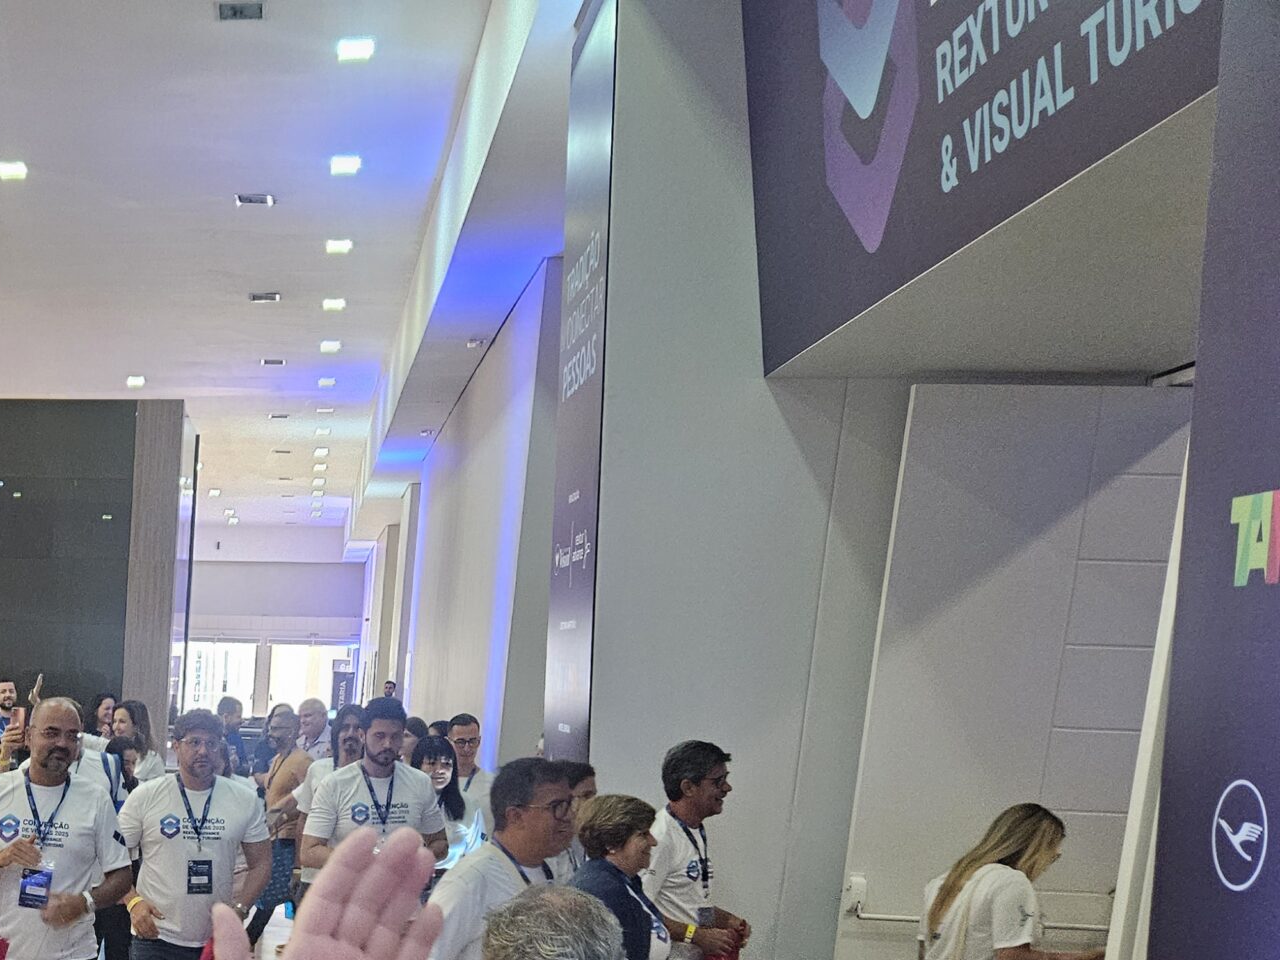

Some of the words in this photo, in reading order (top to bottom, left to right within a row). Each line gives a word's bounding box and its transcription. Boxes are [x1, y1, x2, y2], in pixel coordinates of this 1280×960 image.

[941, 134, 959, 193] &
[962, 41, 1075, 173] VISUAL
[1080, 0, 1202, 85] TUR
[562, 334, 597, 402] PESSOAS
[23, 819, 70, 830] COVEÇÃO
